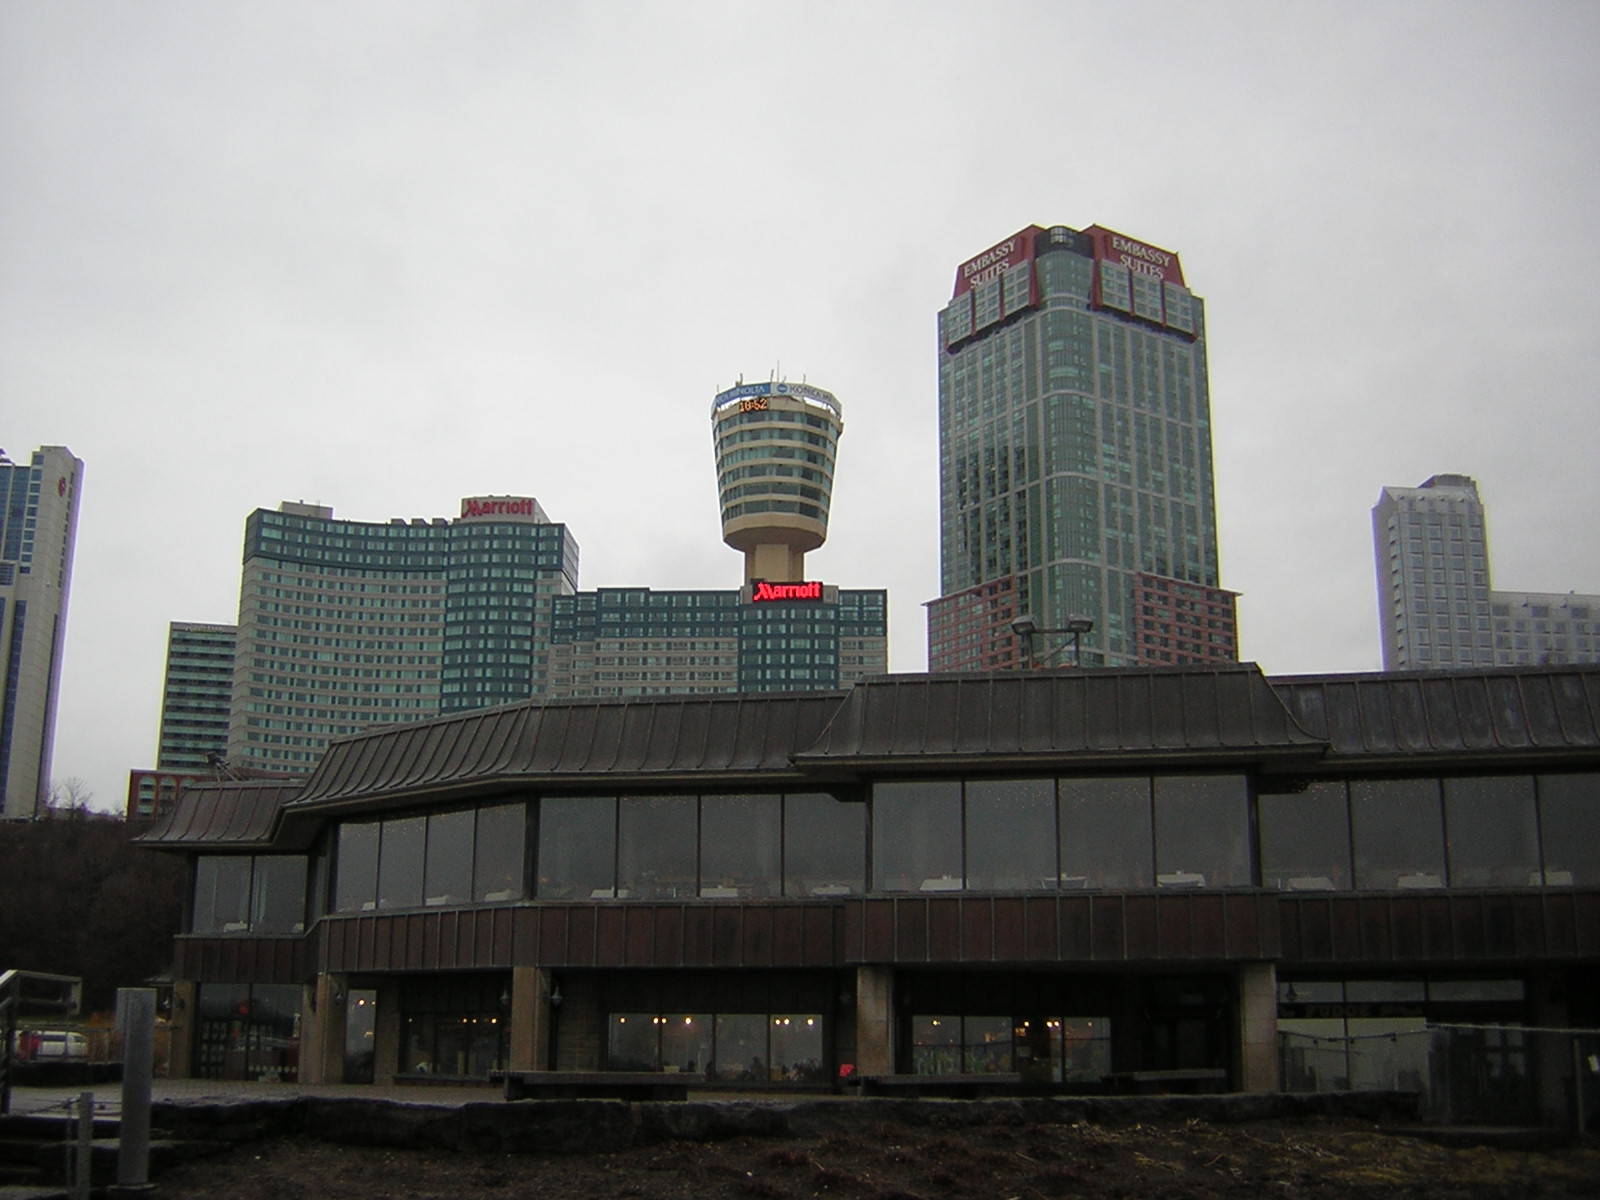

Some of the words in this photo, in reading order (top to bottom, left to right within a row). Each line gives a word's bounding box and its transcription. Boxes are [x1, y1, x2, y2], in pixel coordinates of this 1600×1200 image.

[963, 240, 1016, 278] EMBASSY
[1112, 236, 1170, 268] EMBASSY
[970, 258, 1010, 289] SUITES
[1120, 255, 1164, 280] SUITES
[461, 499, 532, 519] Marriott
[753, 581, 820, 601] Marriott
